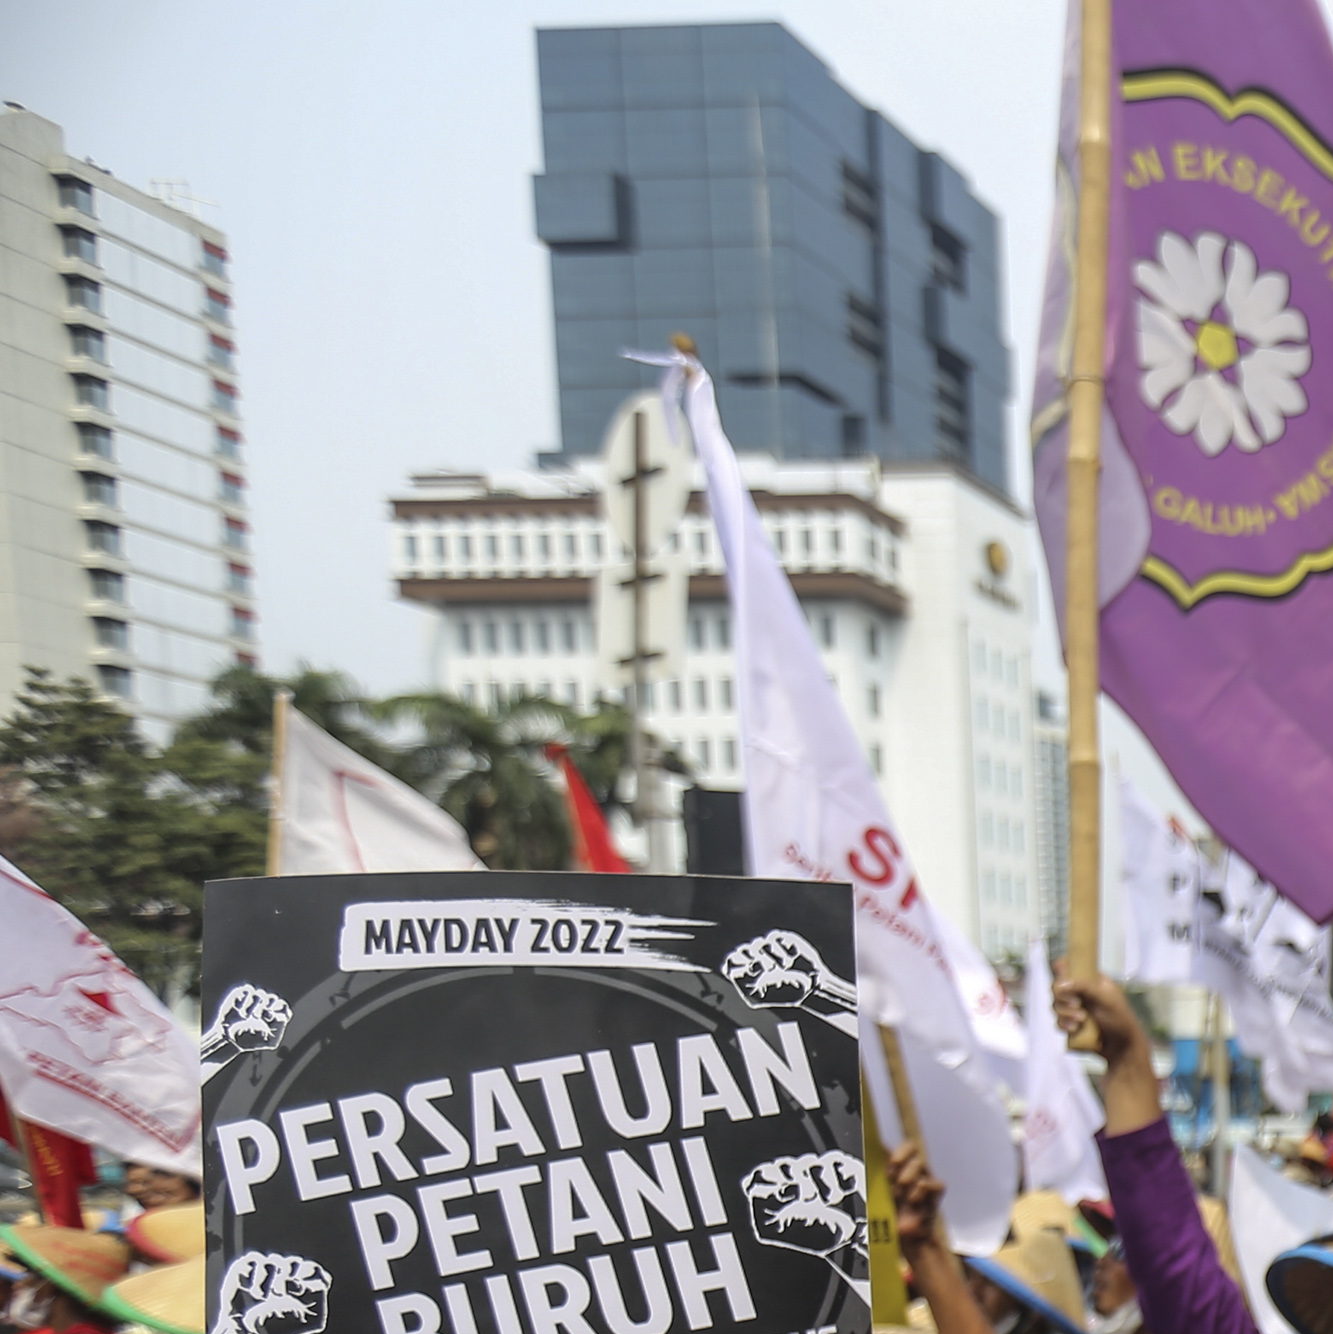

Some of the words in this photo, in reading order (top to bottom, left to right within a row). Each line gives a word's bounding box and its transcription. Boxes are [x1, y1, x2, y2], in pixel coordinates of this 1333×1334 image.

[1153, 487, 1268, 537] GALUH
[363, 916, 521, 955] MAYDAY
[529, 917, 625, 954] 2022
[216, 1021, 821, 1215] PERSATUAN
[349, 1136, 728, 1291] PETANI
